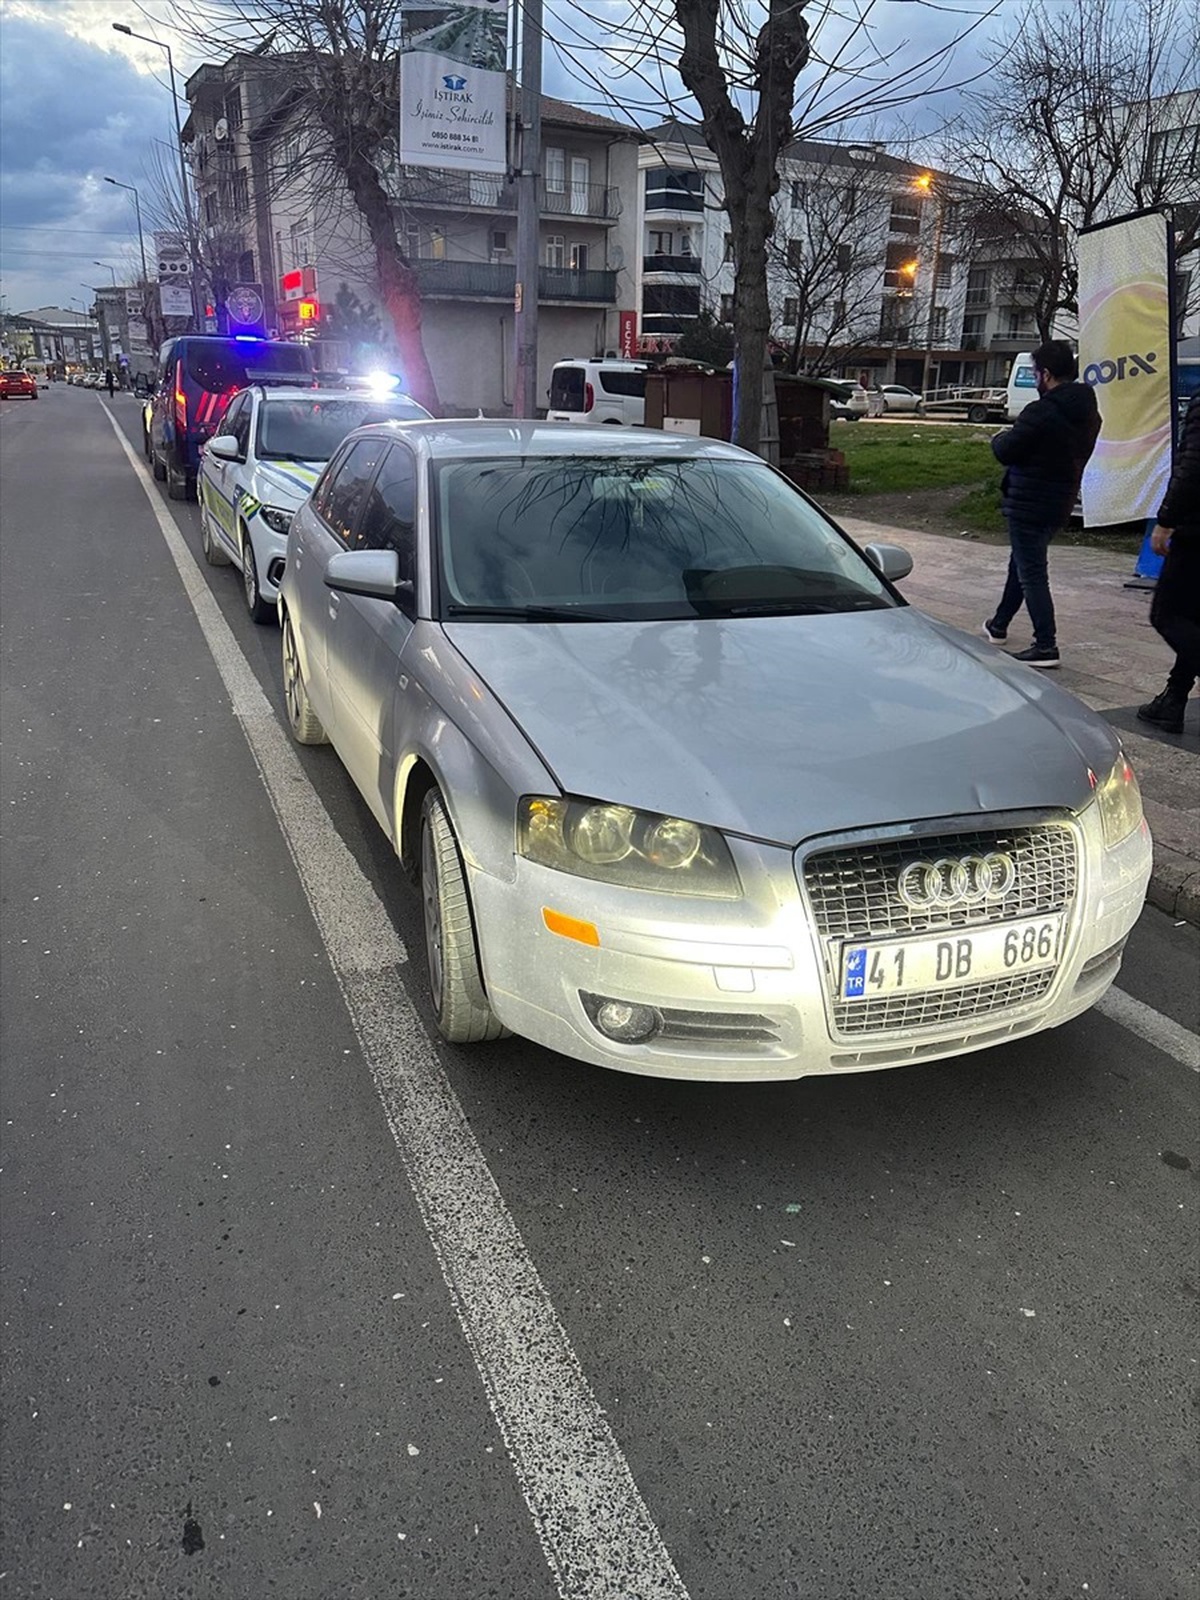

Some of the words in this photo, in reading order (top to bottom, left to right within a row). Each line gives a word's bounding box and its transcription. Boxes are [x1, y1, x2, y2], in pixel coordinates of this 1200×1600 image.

[431, 131, 448, 140] 0850
[462, 134, 471, 142] 34
[868, 948, 905, 990] 41
[936, 938, 973, 981] DB
[1003, 923, 1054, 967] 686
[848, 976, 864, 989] TR
